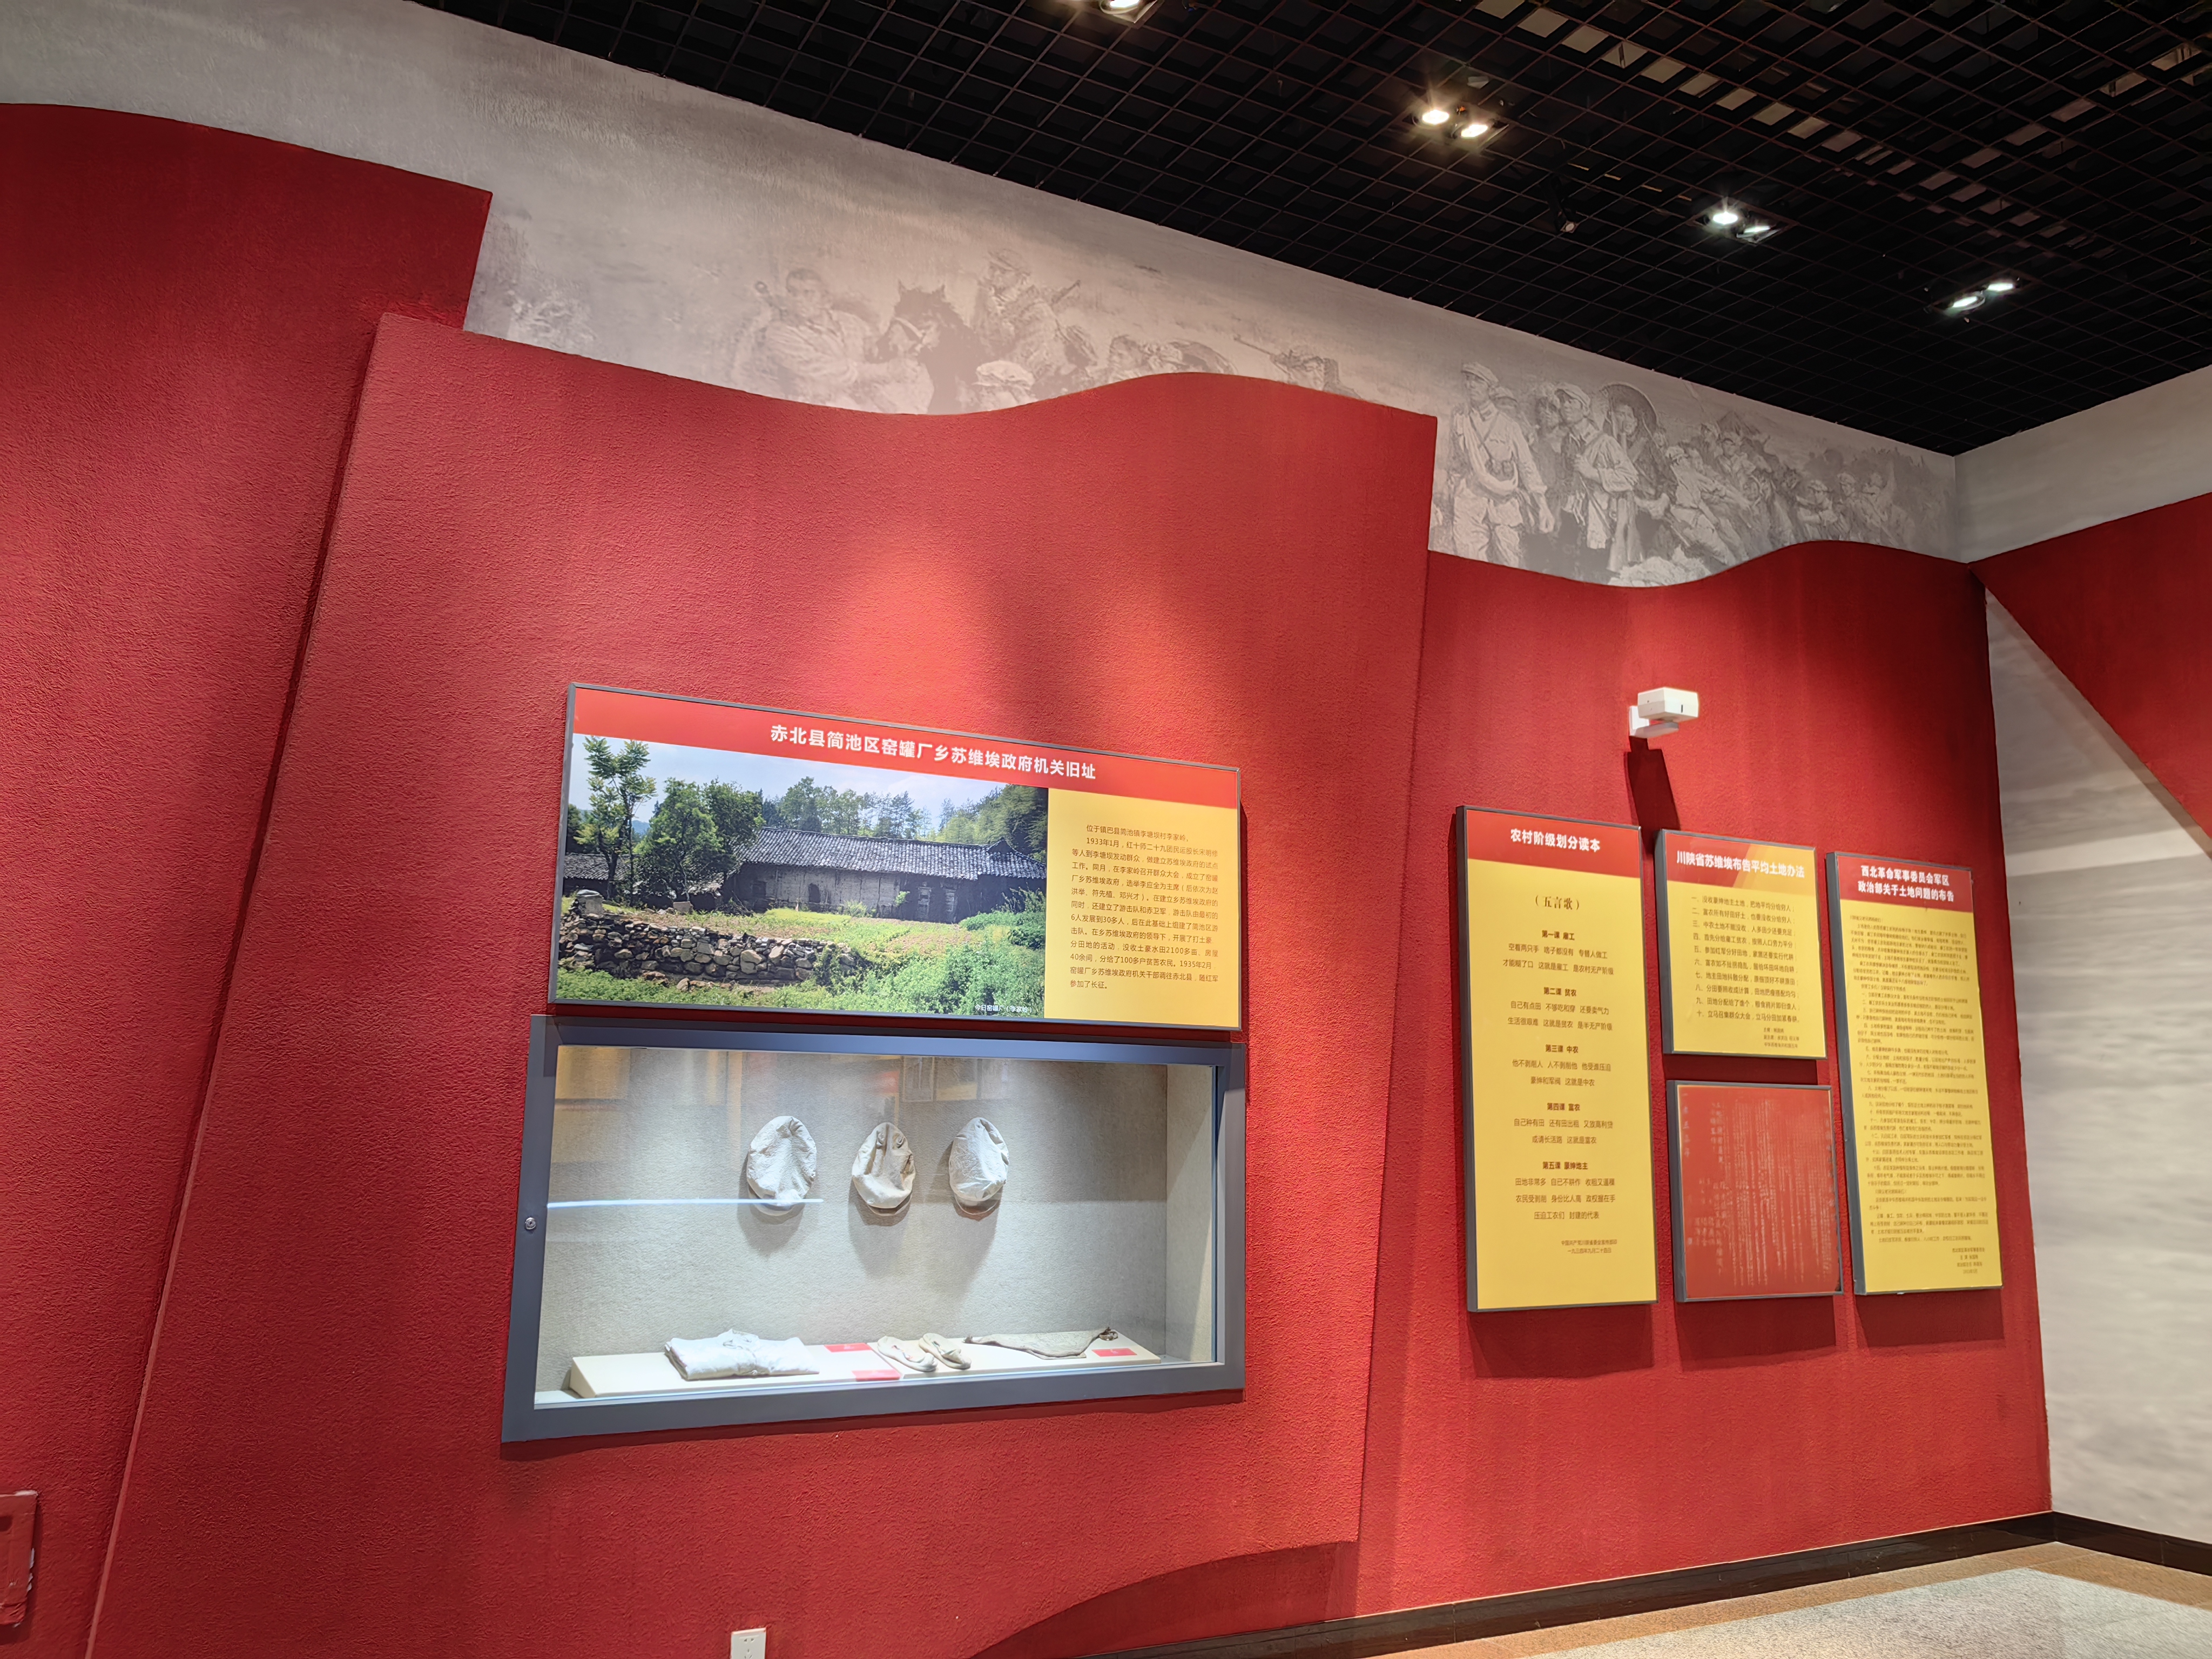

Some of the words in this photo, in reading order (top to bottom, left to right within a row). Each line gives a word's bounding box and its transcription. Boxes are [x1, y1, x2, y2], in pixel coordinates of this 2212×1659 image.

[771, 724, 1096, 779] 赤北县简池区窑罐厂乡苏维埃政府机关旧址
[1087, 838, 1218, 857] 1933年1月，红十师二十九团民运股长宋明修
[1510, 828, 1600, 852] 农村阶级划分读本
[1072, 848, 1218, 869] 等人到李塘坝发动群众，做建立苏维埃政府的试点
[1676, 850, 1805, 878] 川陕省苏维埃布告平均土地办法
[1072, 862, 1218, 882] 工作。同月，在李家岭召开群众大会，成立了窑罐
[1860, 865, 1949, 886] 西北革命军事委员会军区
[1071, 875, 1218, 894] 厂乡苏维埃政府，选举李应全为主席（后依次为赵
[1858, 881, 1954, 902] 政治部关于土地问题的布告
[1071, 901, 1218, 919] 同时，还建立了游击队和赤卫军，游击队由最初的
[1535, 895, 1580, 910] （五言歌）
[1071, 914, 1218, 932] 6人发展到30多人，后在此基础上组建了简池区游
[1542, 930, 1560, 939] 第一课
[1509, 943, 1539, 953] 空着两只手
[1544, 946, 1573, 956] 啥子都没有
[1579, 949, 1607, 959] 专替人做工
[1070, 967, 1218, 982] 窑罐厂乡苏维埃政府机关干部调往赤北县，随红军
[1503, 959, 1533, 968] 才能糊了口
[1573, 965, 1614, 975] 是农村无产阶级
[1070, 980, 1107, 989] 参加了长征。
[1544, 987, 1561, 995] 第二课
[1510, 1001, 1541, 1010] 自己有点田
[1546, 1003, 1575, 1013] 不够吃和穿
[1508, 1017, 1539, 1026] 生活很艰难
[1543, 1019, 1573, 1028] 这就是贫农
[1565, 1078, 1595, 1086] 这就是中农
[1547, 1103, 1565, 1111] 第四课
[1514, 1118, 1545, 1127] 自己种有田
[1549, 1120, 1579, 1128] 还有田出租
[1516, 1195, 1547, 1203] 农民受剥削
[1551, 1195, 1581, 1203] 身份比人高
[1534, 1211, 1564, 1219] 压迫工农们
